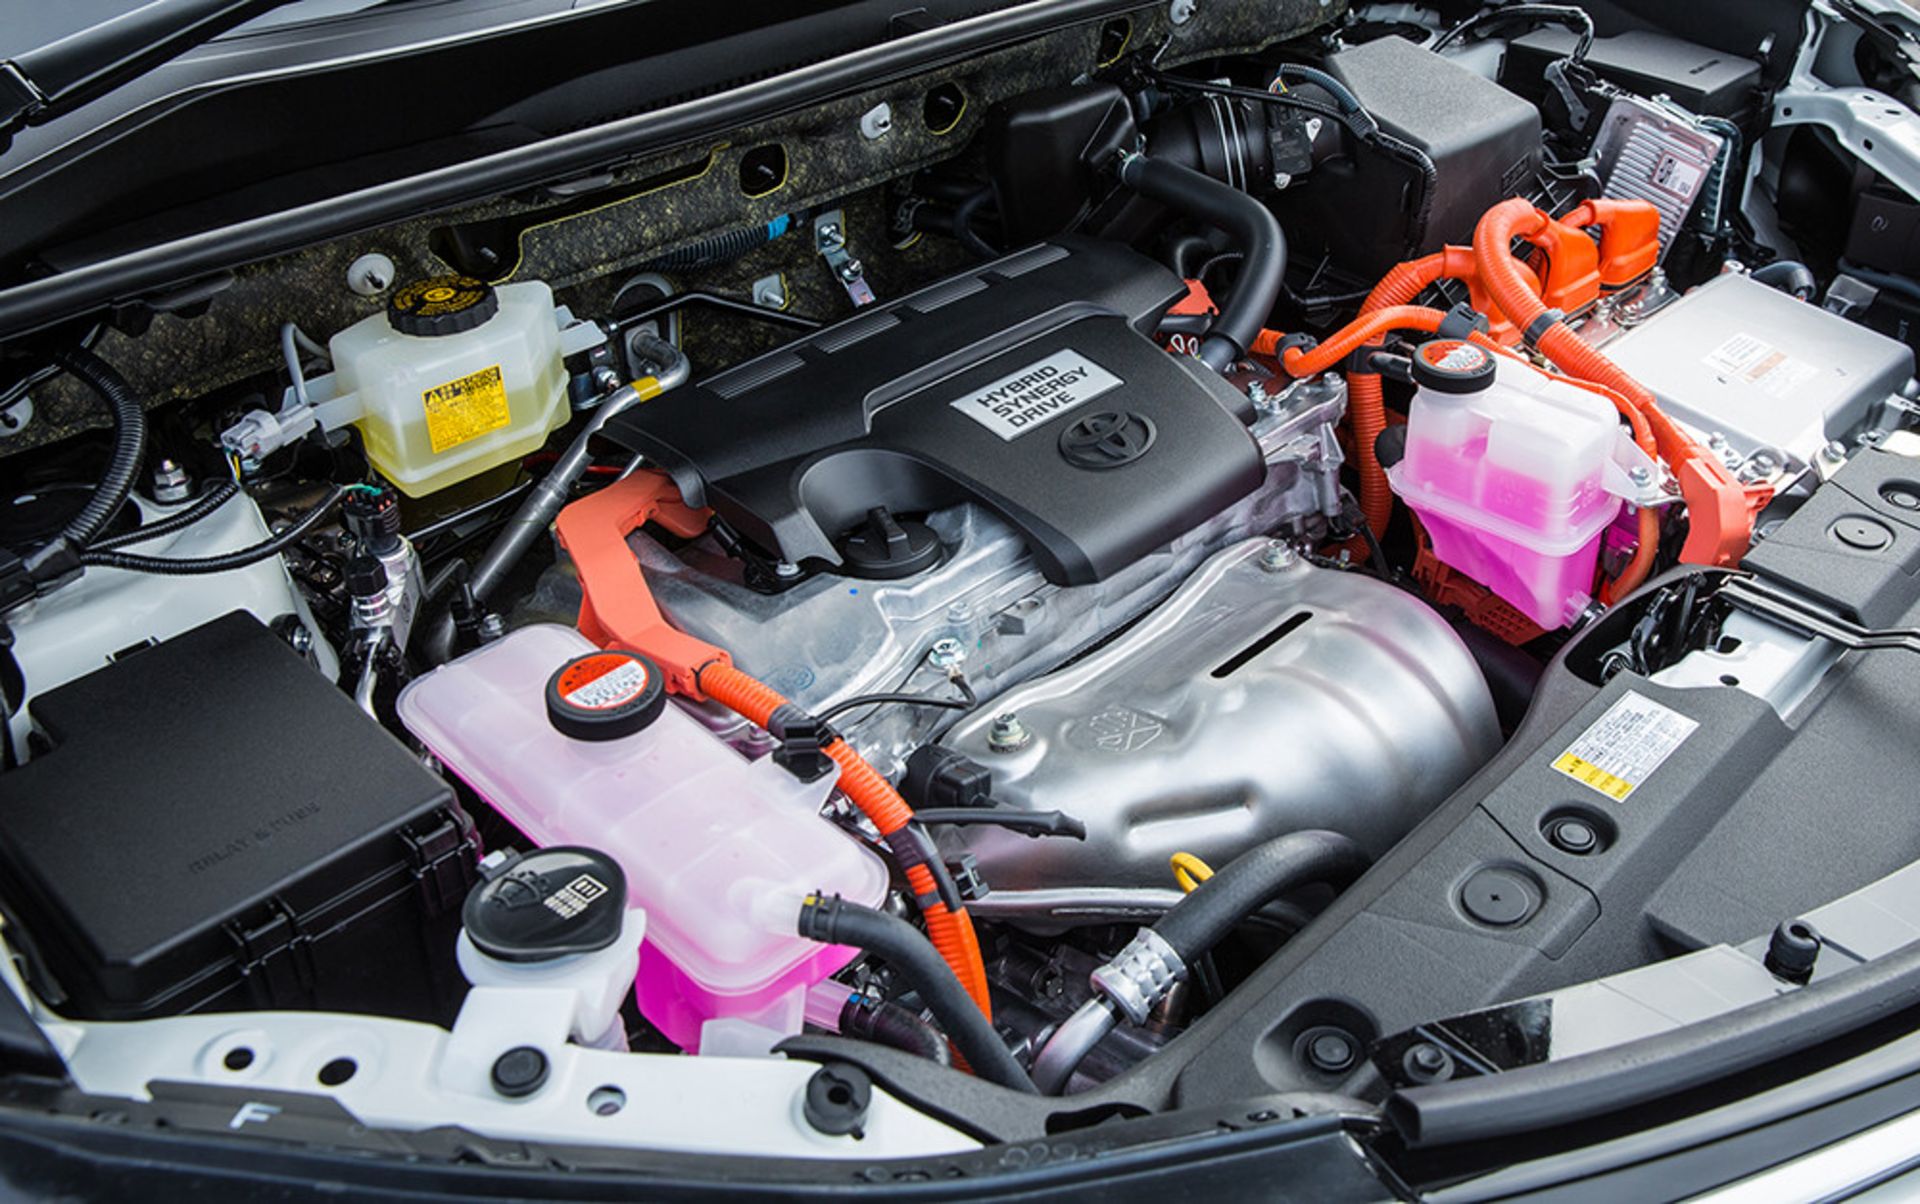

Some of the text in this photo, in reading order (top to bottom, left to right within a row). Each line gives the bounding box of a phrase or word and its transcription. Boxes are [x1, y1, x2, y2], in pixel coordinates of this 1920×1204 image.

[976, 365, 1059, 408] HYBRID
[992, 366, 1089, 418] SYNERGY
[1008, 390, 1076, 428] DRIVE
[229, 1101, 283, 1130] F
